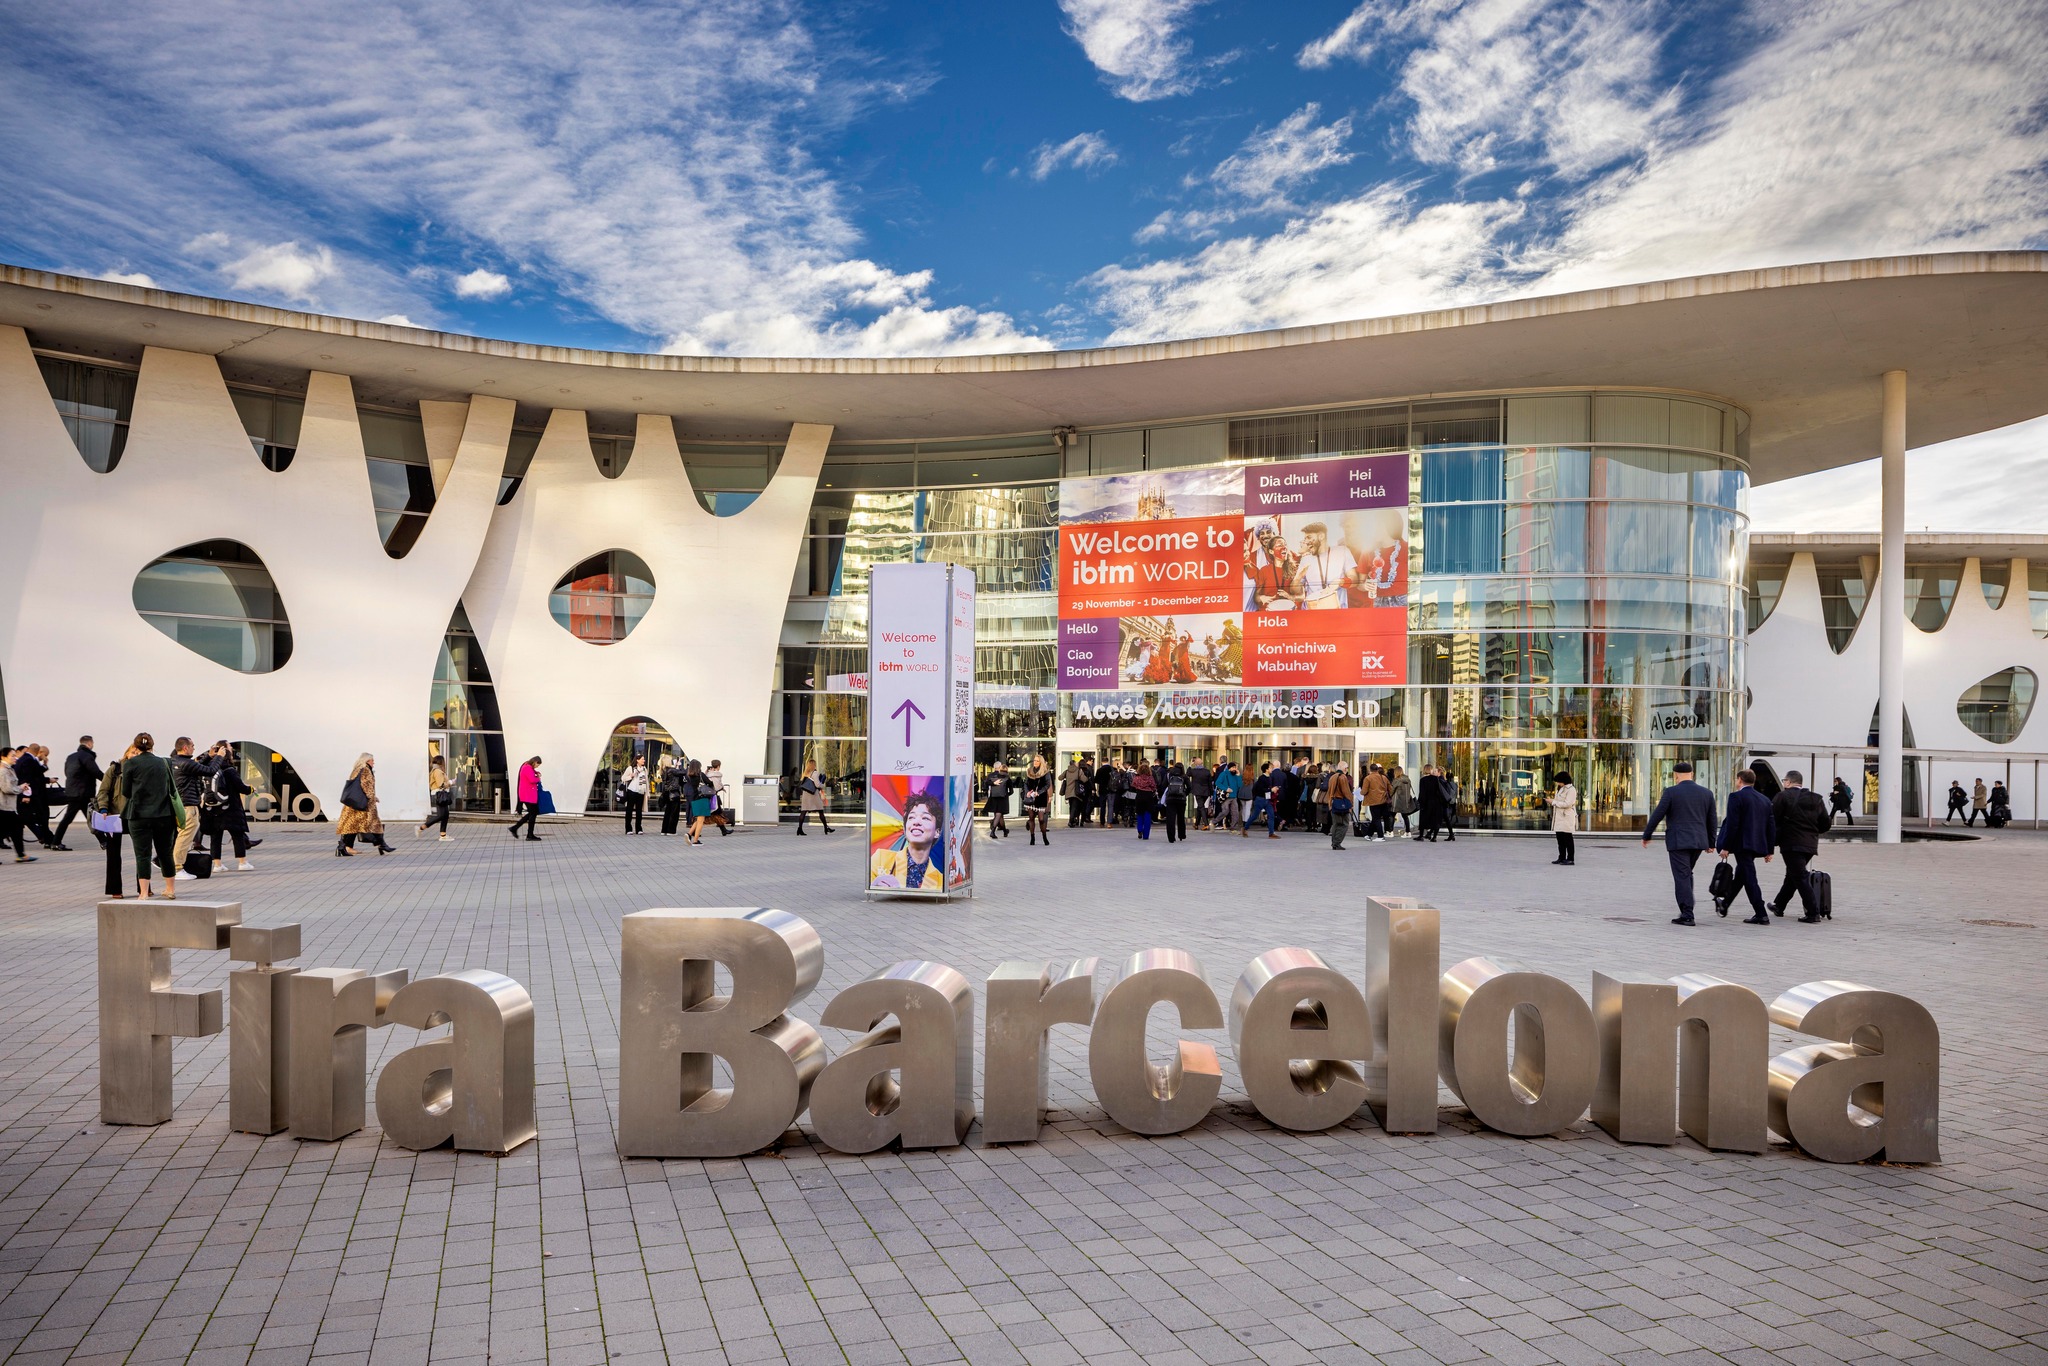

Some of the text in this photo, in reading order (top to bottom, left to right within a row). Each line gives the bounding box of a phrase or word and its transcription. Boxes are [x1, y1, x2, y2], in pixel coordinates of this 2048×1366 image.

[1259, 472, 1319, 488] Dia dhuit
[1349, 468, 1372, 481] Hei
[1259, 492, 1303, 505] Witam
[1350, 485, 1386, 499] Hallå
[1068, 525, 1235, 556] Welcome to
[1072, 559, 1230, 585] ibtm WORLD
[1071, 601, 1084, 610] 29
[1085, 598, 1135, 609] November
[1143, 599, 1149, 607] 1
[1151, 596, 1203, 607] December
[1204, 594, 1229, 604] 2022
[1066, 623, 1098, 635] Hello
[1257, 616, 1288, 628] Hola
[881, 632, 937, 643] Welcome
[903, 647, 915, 658] to
[1067, 649, 1093, 660] Ciao
[1257, 642, 1337, 655] Kon'nichiwa
[879, 661, 939, 672] ibtm WORLD
[1257, 660, 1318, 674] Mabuhay
[1362, 655, 1385, 670] RX
[1066, 665, 1113, 679] Bonjour
[847, 672, 868, 690] Welc
[1172, 691, 1236, 706] Downlod
[1260, 690, 1298, 703] mobe
[1300, 689, 1319, 703] app
[1331, 699, 1380, 719] SUD
[240, 784, 322, 821] clo
[97, 896, 1941, 1164] Fira Barcelona
